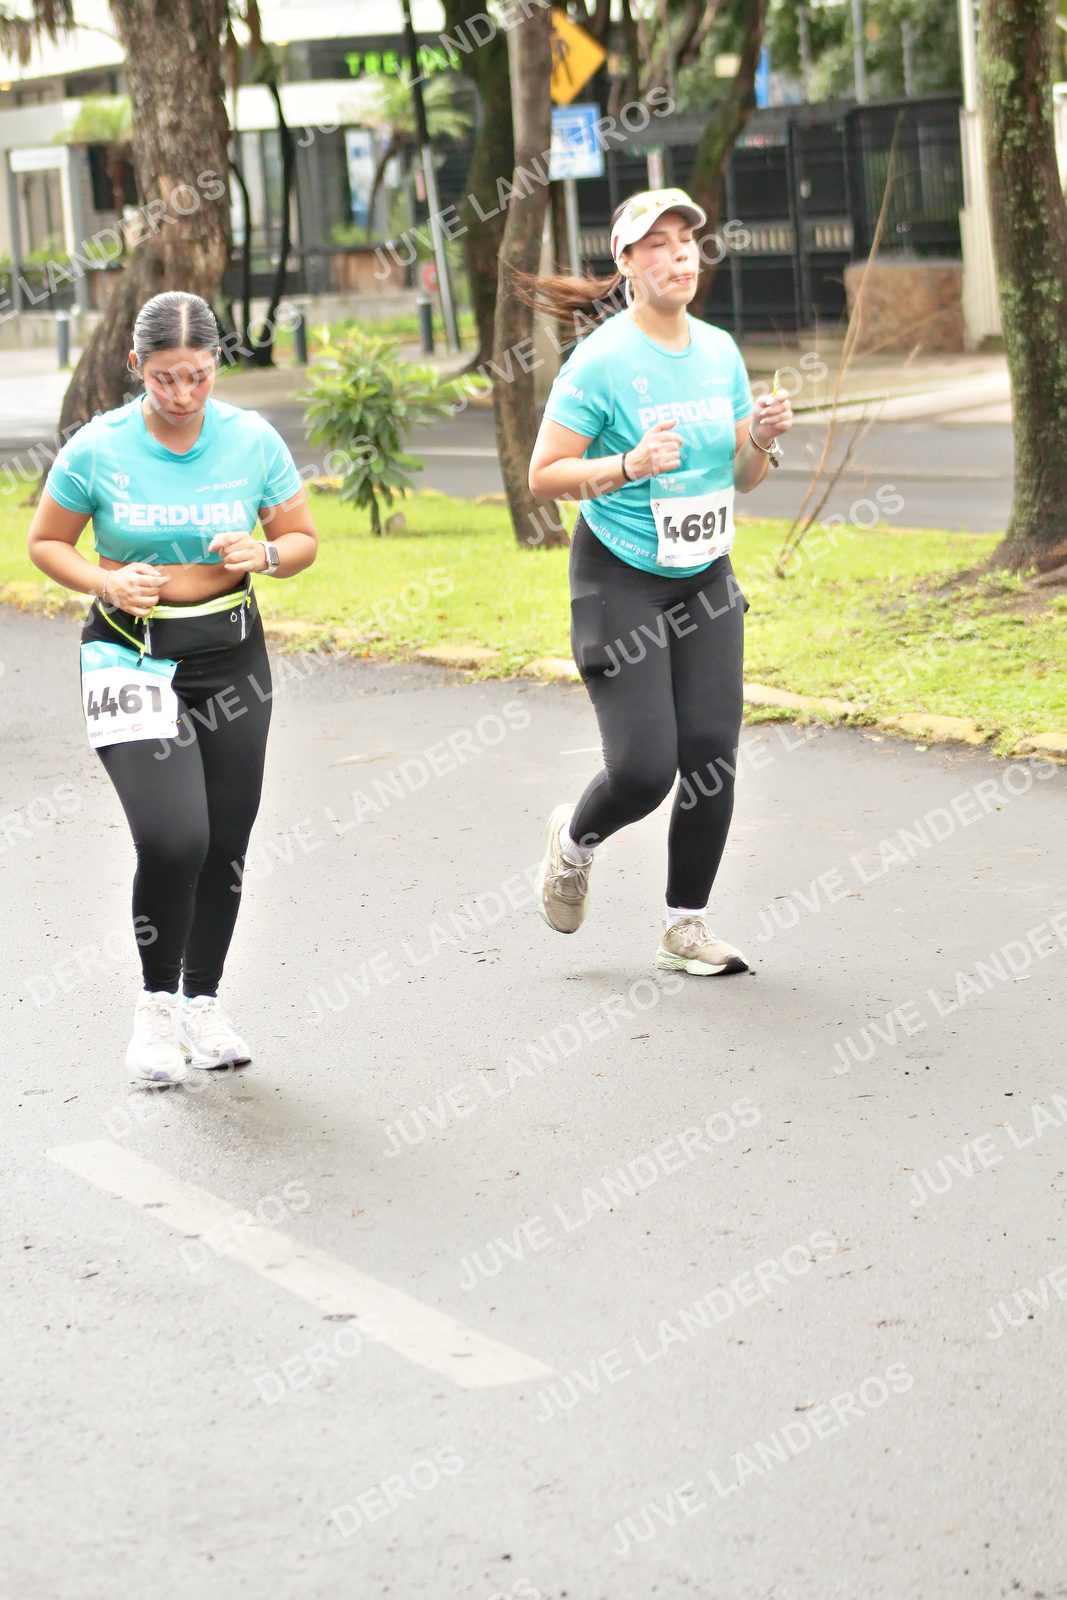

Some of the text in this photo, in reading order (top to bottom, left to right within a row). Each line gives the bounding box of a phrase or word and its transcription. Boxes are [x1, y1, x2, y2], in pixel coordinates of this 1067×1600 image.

[112, 499, 247, 526] PERDURA
[663, 506, 727, 543] 4691
[619, 540, 650, 557] amigos
[87, 683, 162, 721] 4461
